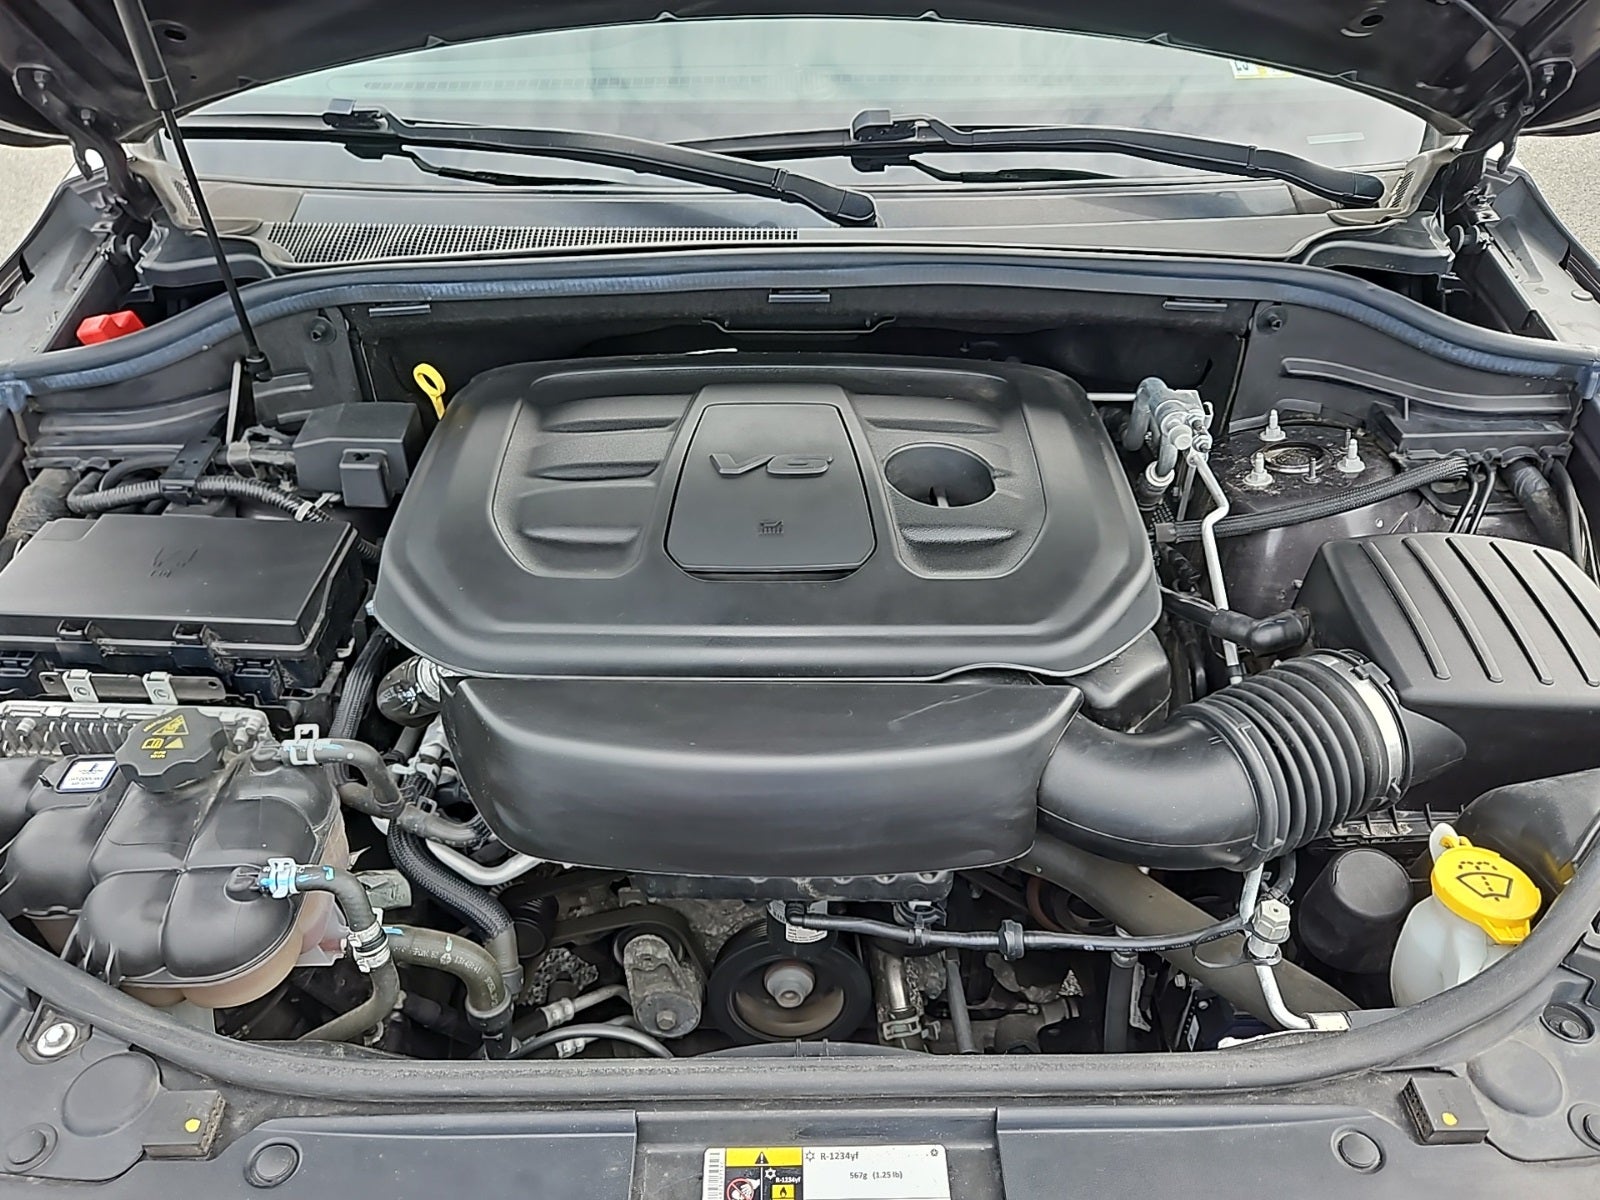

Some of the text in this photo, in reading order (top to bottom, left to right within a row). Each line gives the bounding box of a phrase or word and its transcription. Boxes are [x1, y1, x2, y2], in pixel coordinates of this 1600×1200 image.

[709, 453, 834, 476] V6
[820, 1151, 859, 1161] R-1234yf
[849, 1171, 868, 1180] 567g
[872, 1171, 891, 1180] (1.25
